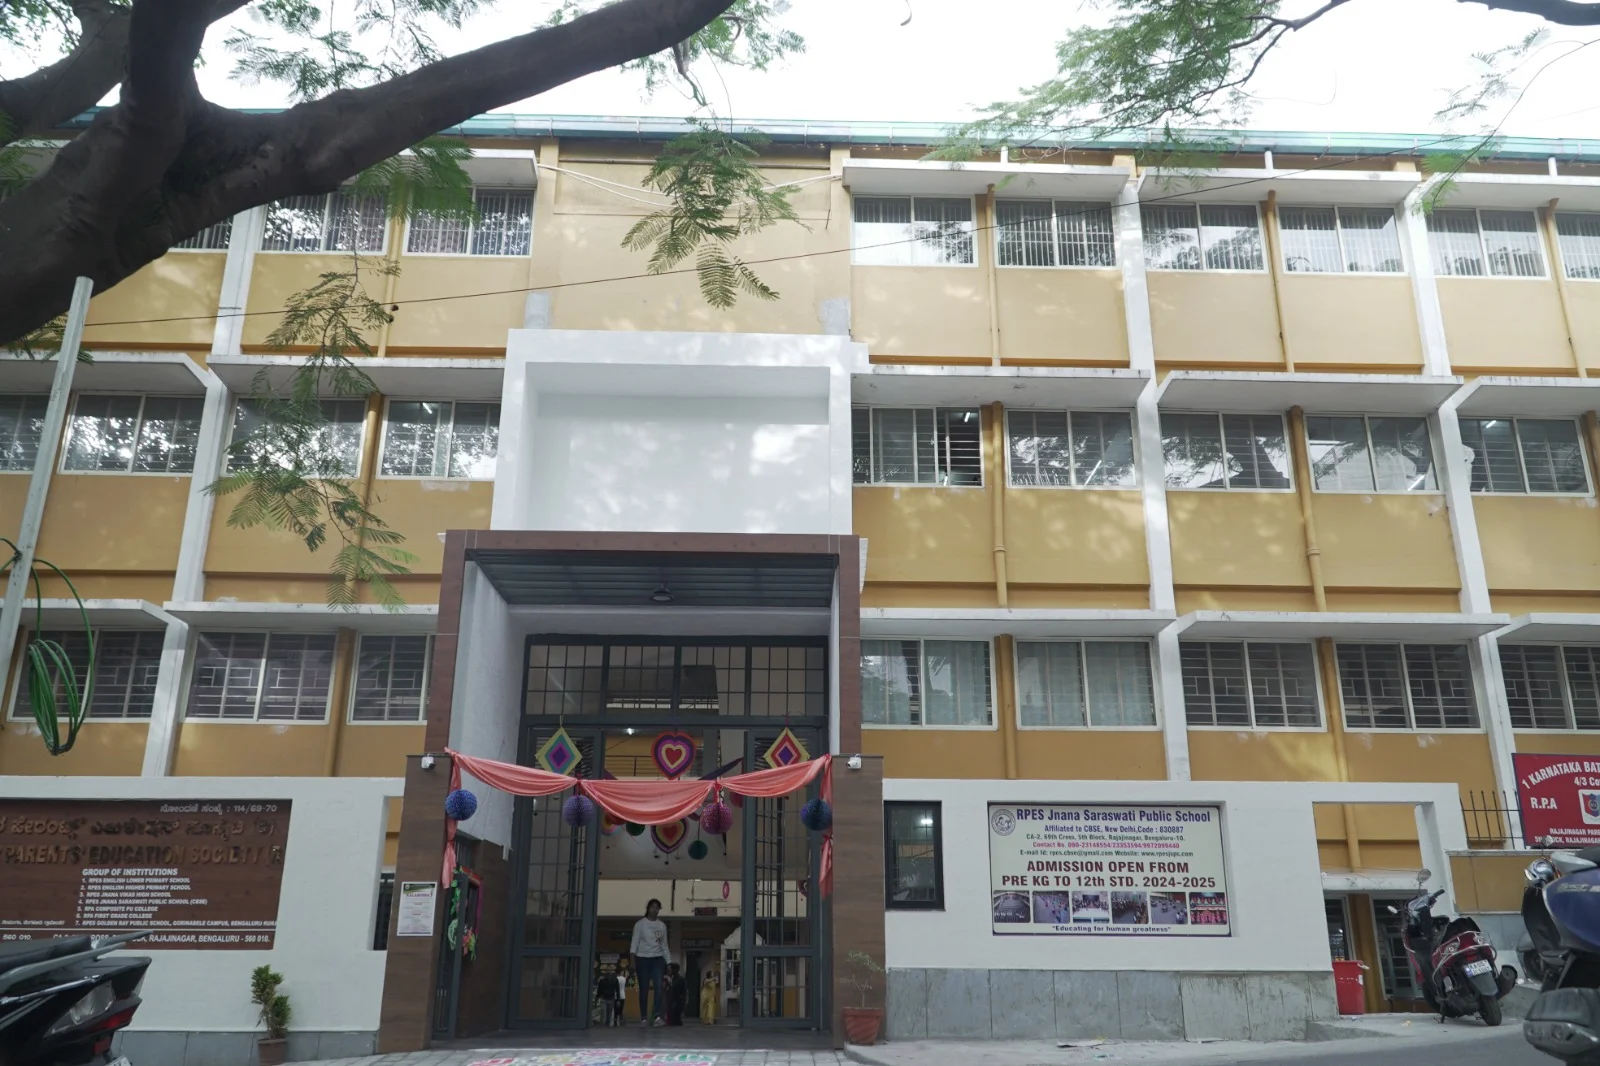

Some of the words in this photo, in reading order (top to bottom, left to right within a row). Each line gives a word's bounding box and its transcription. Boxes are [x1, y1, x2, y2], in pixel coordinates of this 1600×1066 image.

[1521, 779, 1530, 789] 1
[1528, 762, 1582, 785] KARNATAKA
[1573, 776, 1587, 787] 4/3
[1530, 797, 1558, 810] R.P.A
[1016, 808, 1045, 820] RPES
[1047, 809, 1080, 821] Jnana
[1083, 809, 1136, 822] Saraswati
[1139, 810, 1172, 822] Public
[1175, 810, 1211, 822] School
[1549, 827, 1586, 835] RAJAJINAGAR
[88, 846, 186, 865] EDUCATION
[191, 846, 264, 865] SOCIETY
[82, 868, 110, 876] GROUP
[111, 868, 122, 876] OF
[123, 868, 178, 876] INSTITUTIONS
[1027, 860, 1103, 872] ADMISSION
[1108, 861, 1145, 873] OPEN
[1149, 861, 1189, 873] FROM
[1002, 875, 1028, 886] PRE
[1032, 875, 1050, 887] KG
[1053, 875, 1071, 887] TO
[1075, 875, 1105, 887] 12th
[1109, 876, 1139, 887] STD.
[1142, 876, 1216, 888] 2024-2025
[149, 935, 197, 943] RAJAJINAGAR,
[198, 935, 240, 943] BENGALURU
[244, 935, 256, 943] 560
